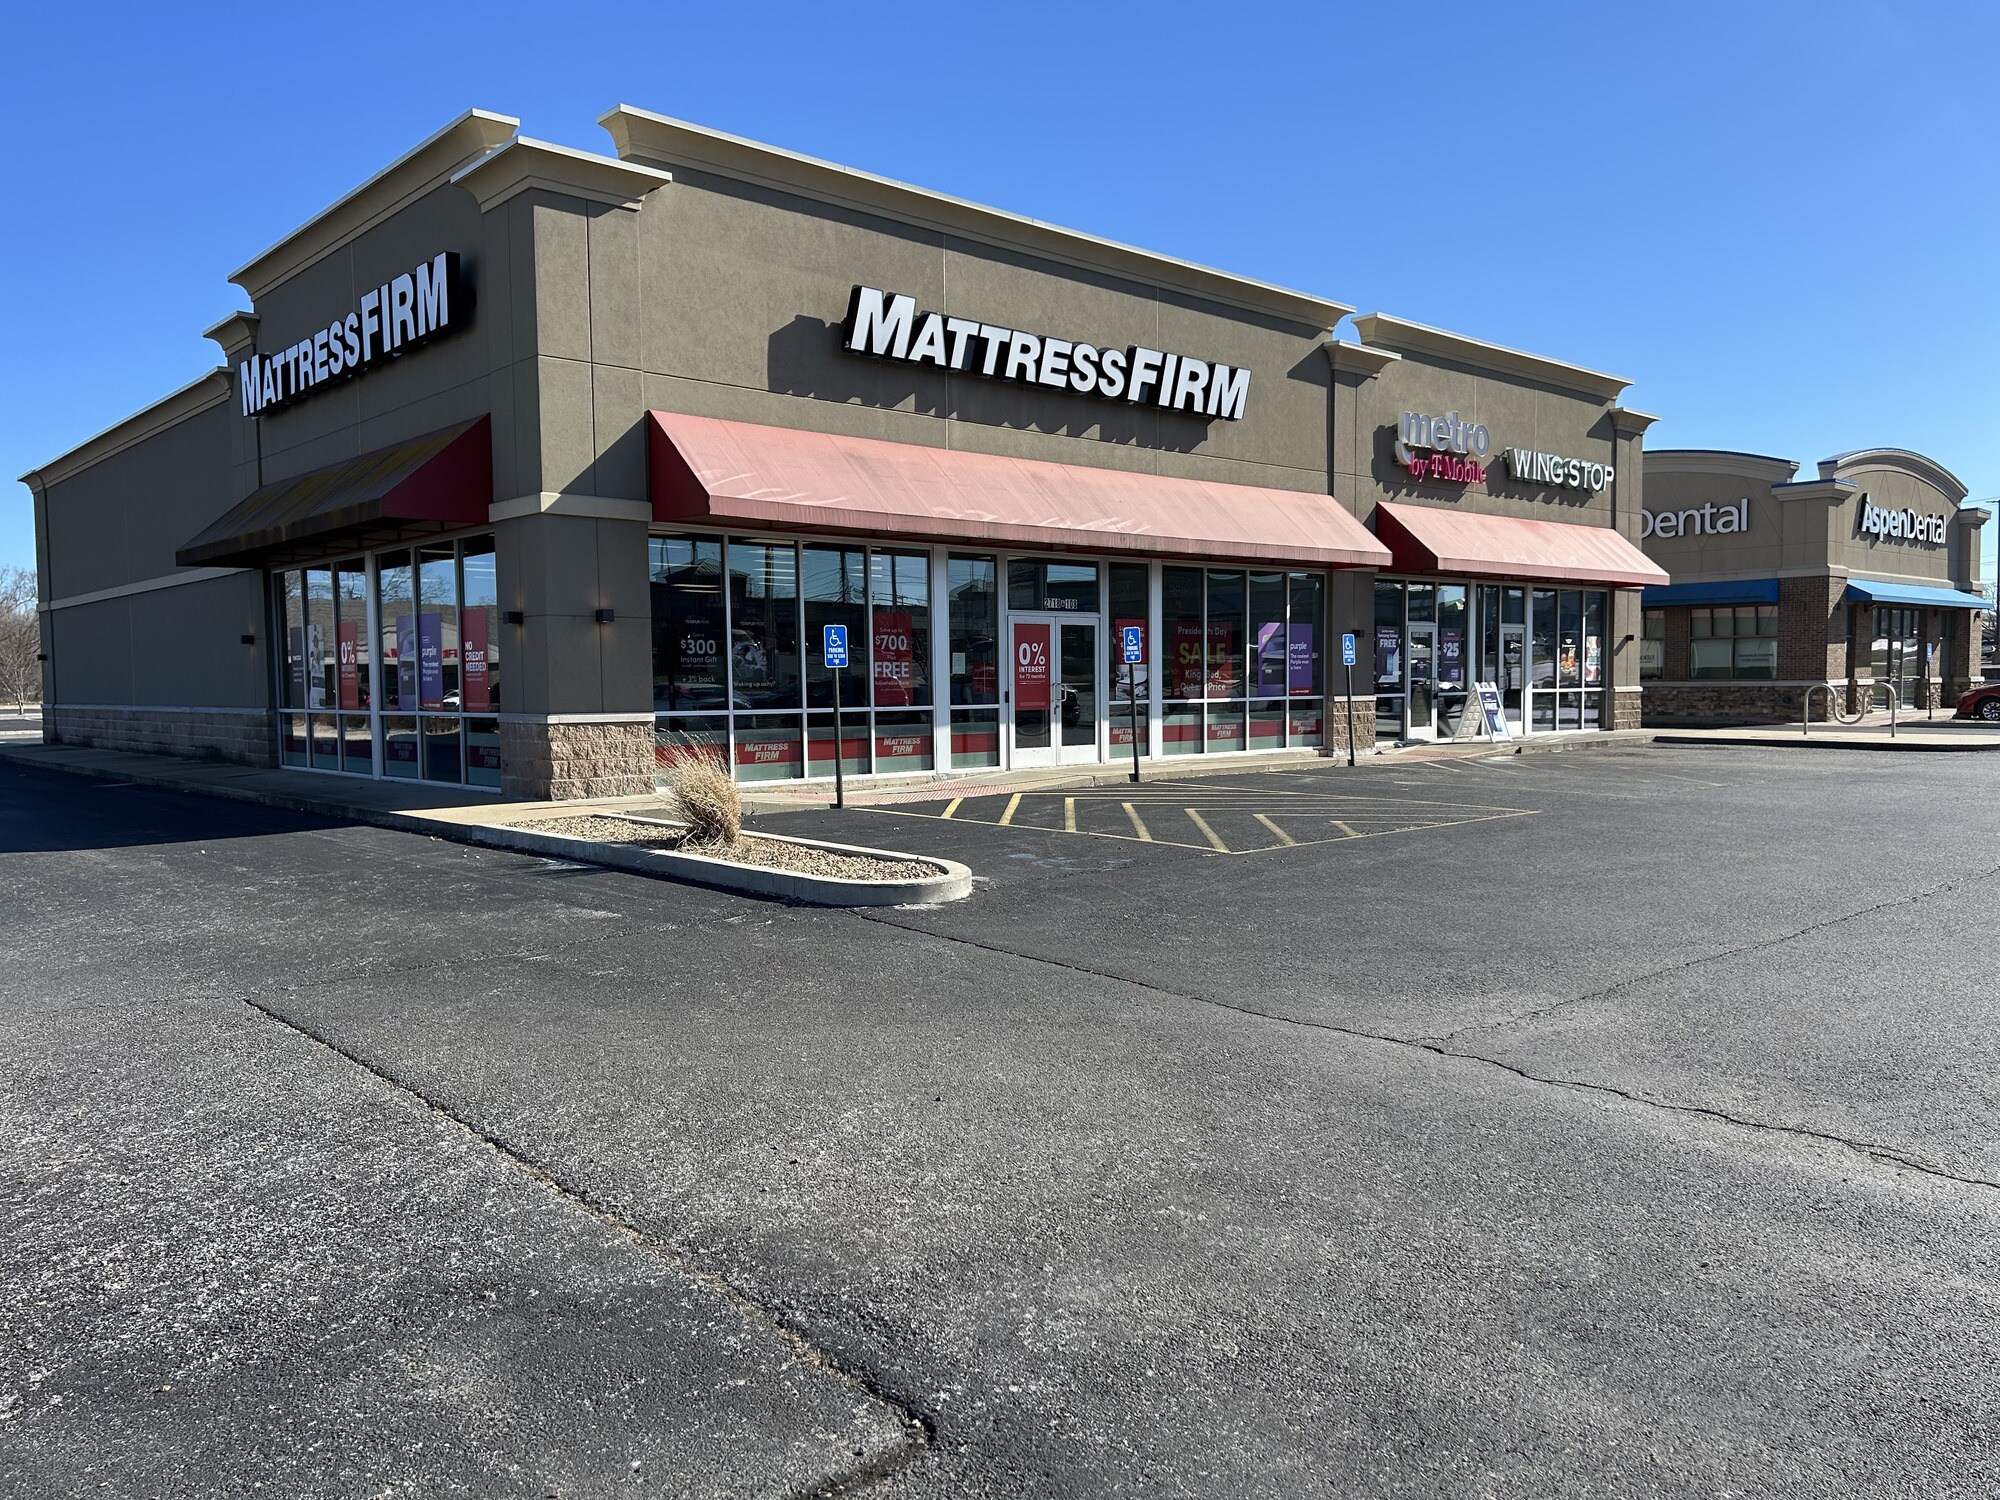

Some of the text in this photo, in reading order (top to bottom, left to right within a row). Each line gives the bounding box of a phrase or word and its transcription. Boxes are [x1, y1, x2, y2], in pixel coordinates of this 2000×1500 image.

[1403, 410, 1490, 458] metro
[1410, 450, 1429, 482] by
[1214, 626, 1228, 638] Day
[464, 641, 473, 651] NO
[680, 639, 717, 655] $300
[875, 634, 908, 651] $700
[1289, 641, 1308, 651] purple
[1379, 638, 1397, 648] FREE
[341, 640, 355, 664] 0%
[421, 645, 437, 658] purple
[1018, 642, 1046, 665] 0%
[1179, 642, 1226, 665] SALE
[1442, 642, 1460, 657] $25
[465, 651, 484, 661] CREDIT
[680, 655, 718, 664] Instant Gift
[465, 662, 487, 672] NEEDED
[874, 661, 910, 678] FREE
[698, 675, 716, 683] back
[1184, 669, 1202, 680] King
[1207, 681, 1227, 691] Price
[1210, 723, 1237, 731] MATTRESS
[1216, 729, 1232, 738] FIRM
[744, 742, 789, 752] MATTRESS
[883, 737, 921, 746] MATTRESS
[891, 744, 913, 755] FIRM
[754, 750, 780, 761] FIRM
